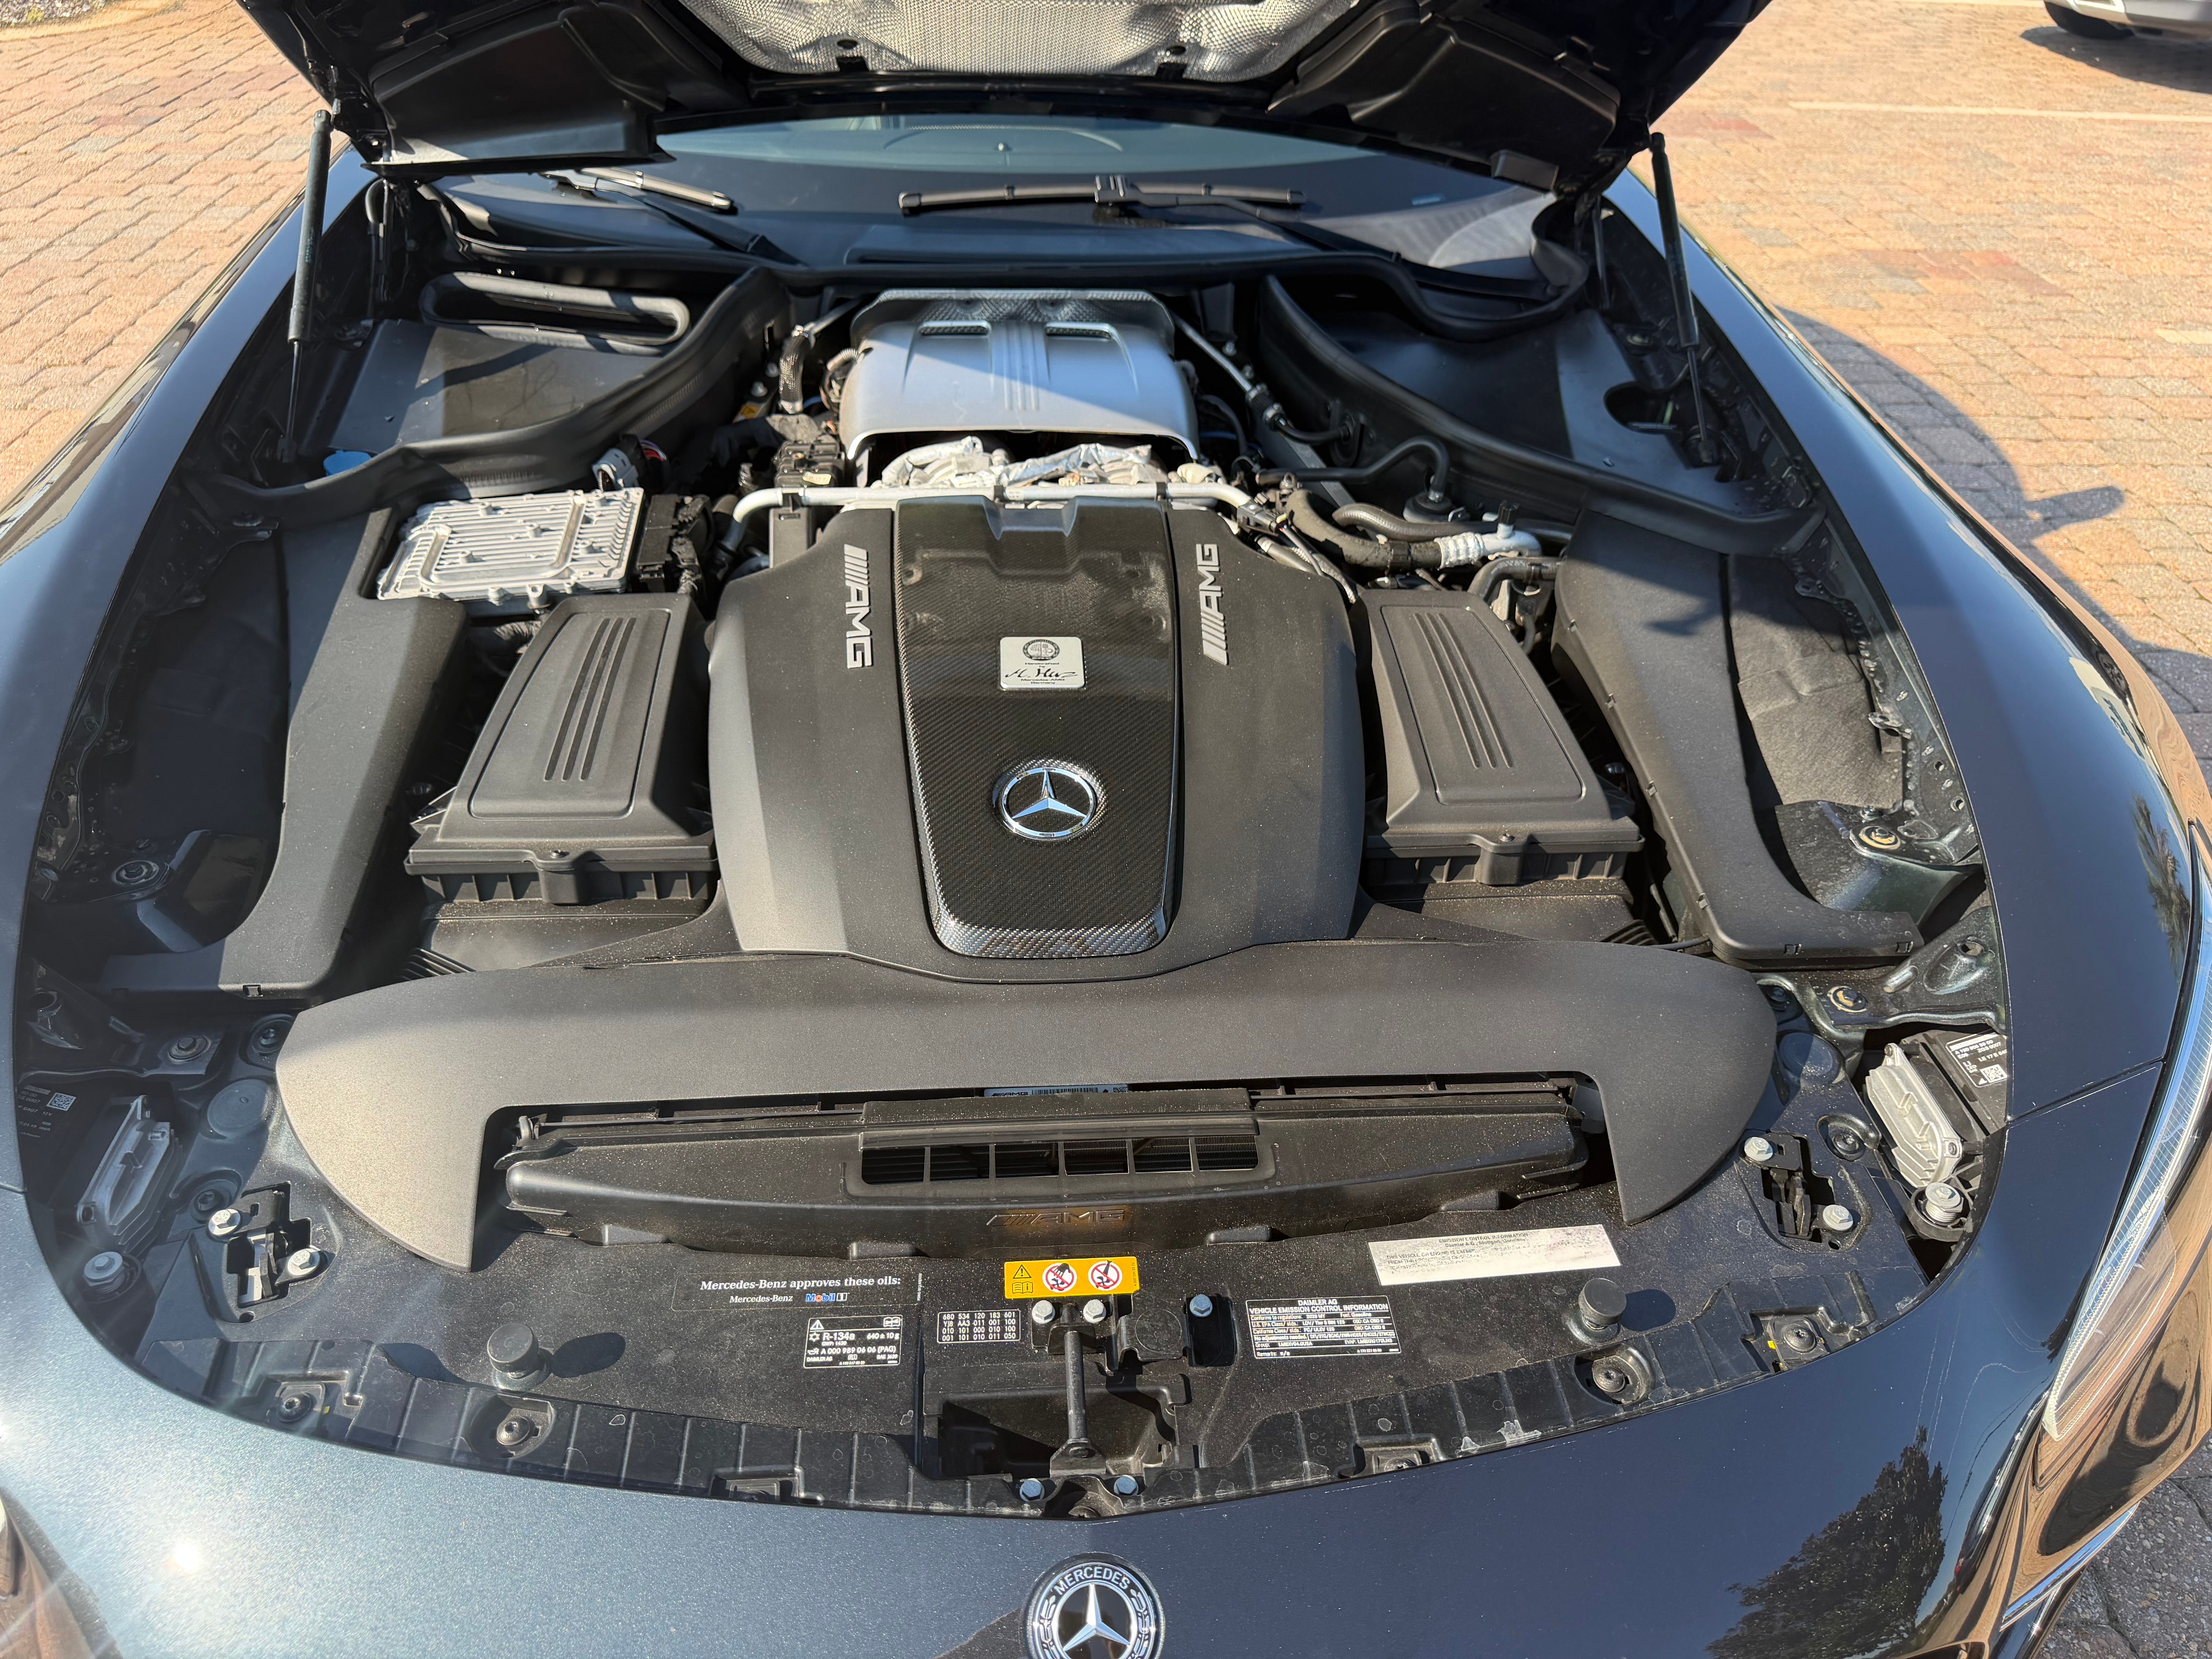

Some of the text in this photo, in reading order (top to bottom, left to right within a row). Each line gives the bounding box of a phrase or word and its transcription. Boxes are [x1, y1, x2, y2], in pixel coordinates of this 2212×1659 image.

[700, 1276, 901, 1290] Mercedes-Benz approves these oils:
[729, 1295, 793, 1303] Mercedes-Benz
[805, 1292, 836, 1302] Mobil
[823, 1332, 855, 1341] R-134a
[1054, 1566, 1131, 1595] MERCEDES
